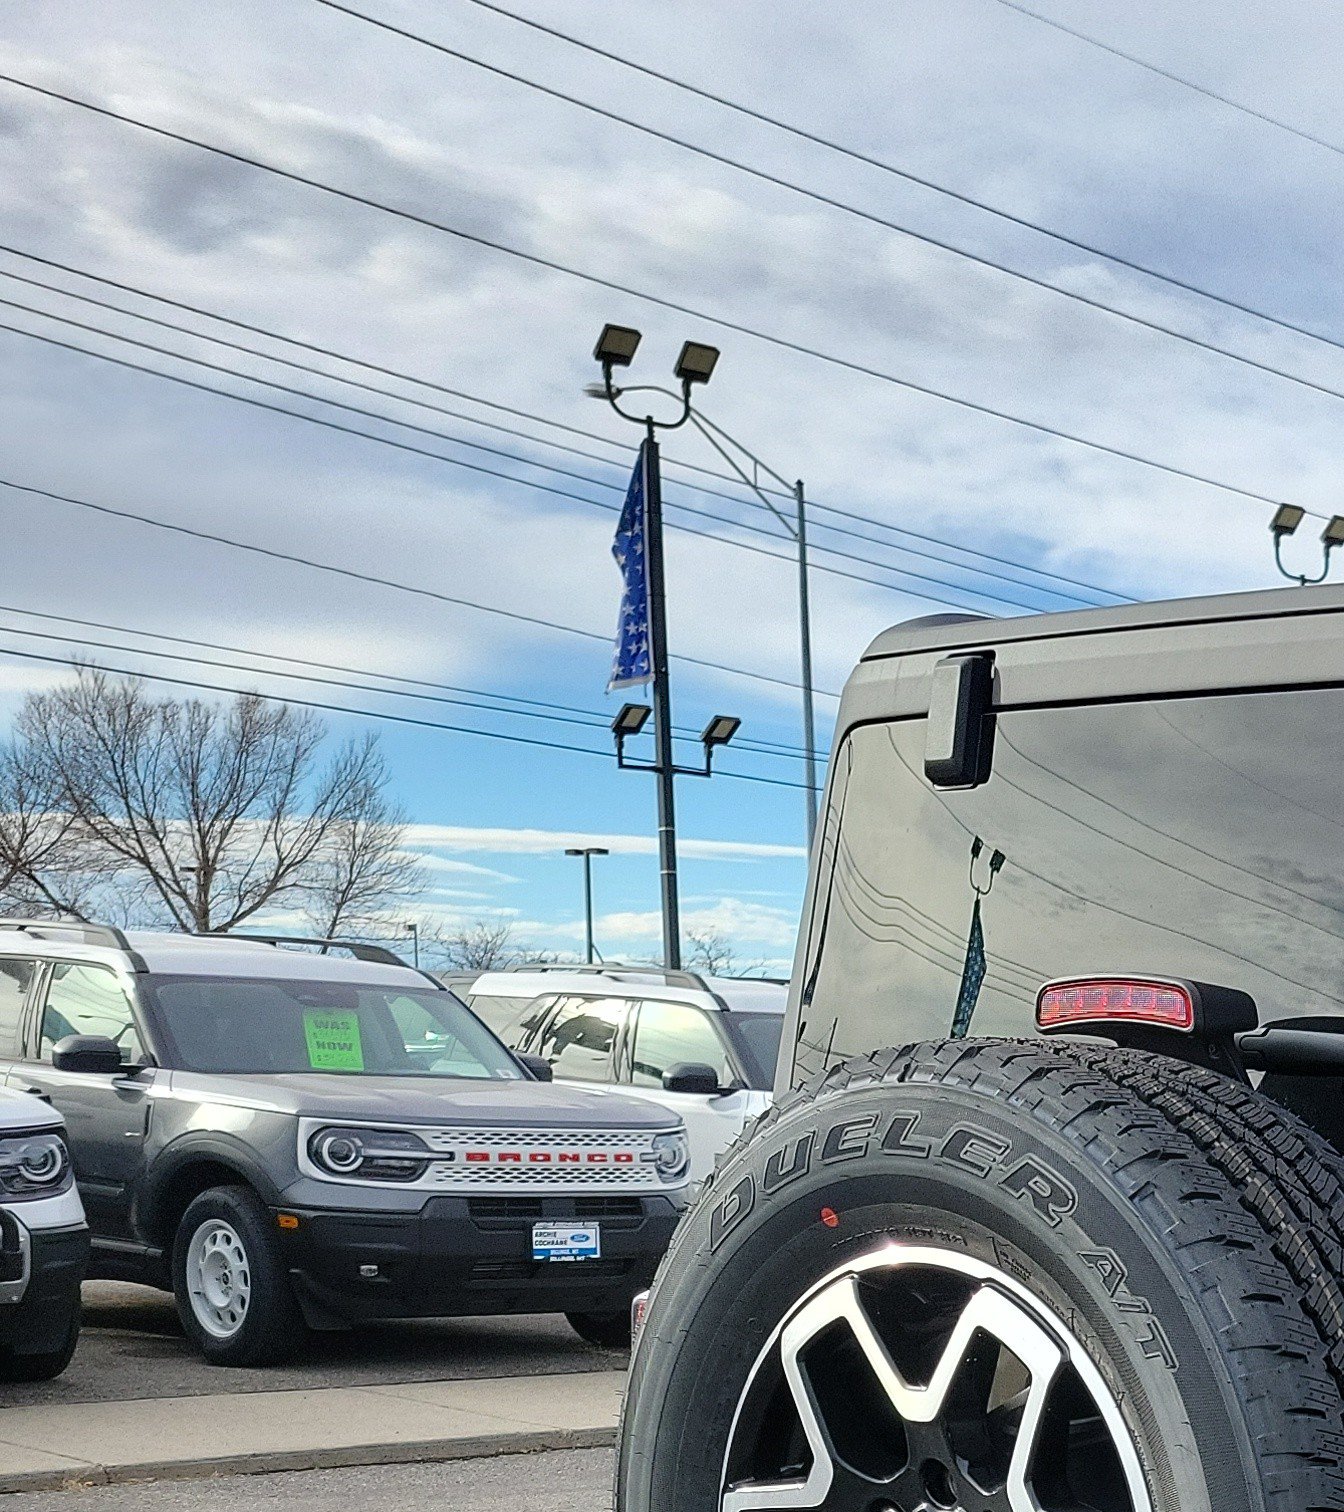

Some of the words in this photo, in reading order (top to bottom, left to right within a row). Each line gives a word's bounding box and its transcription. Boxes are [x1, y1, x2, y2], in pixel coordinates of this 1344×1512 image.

[466, 1152, 634, 1163] BRONCO
[710, 1108, 1078, 1254] DUELER
[534, 1239, 568, 1247] COCHRANE
